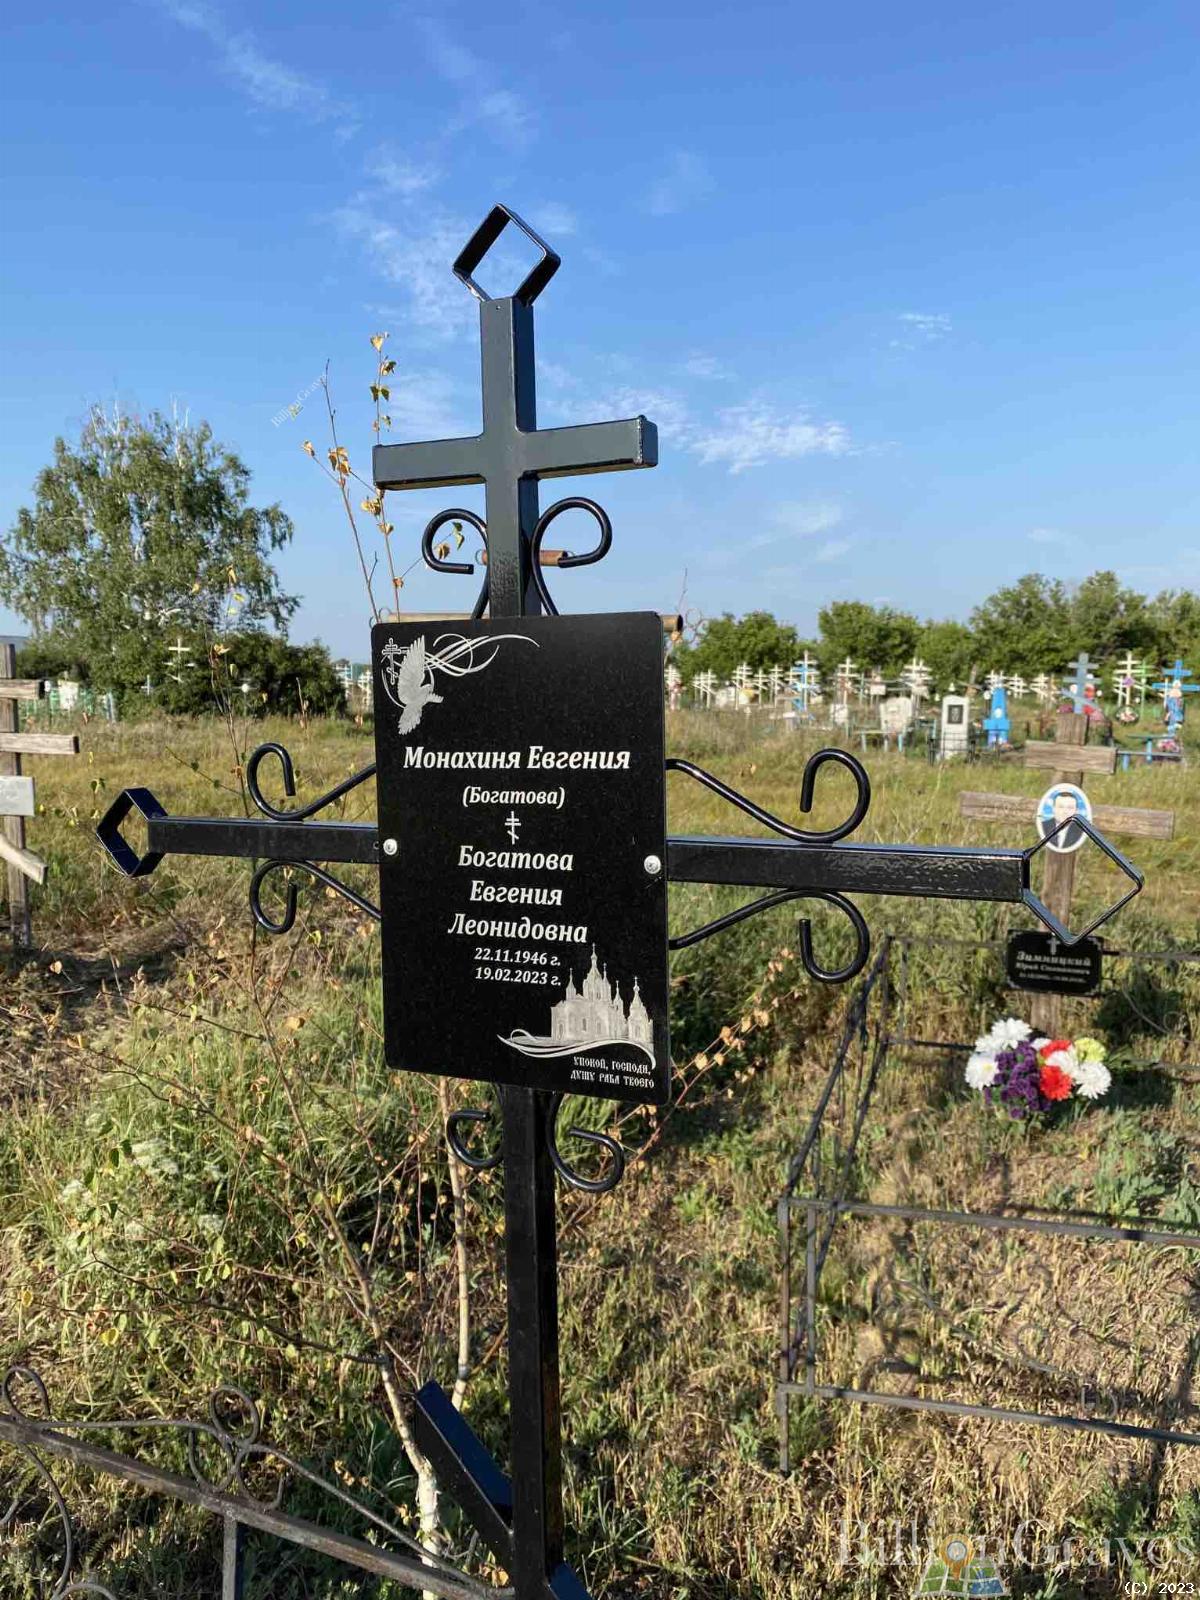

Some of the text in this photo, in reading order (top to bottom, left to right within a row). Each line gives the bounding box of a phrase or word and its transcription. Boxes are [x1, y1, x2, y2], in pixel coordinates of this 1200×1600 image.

[403, 746, 631, 770] Монахиня Евгения
[462, 786, 566, 810] (Богатова)
[458, 845, 574, 871] Богатова
[470, 880, 563, 906] Евгения
[448, 913, 588, 943] Леонидовна
[473, 947, 562, 967] 22.11.1946 г.
[475, 967, 562, 987] 19.02.2023 г.
